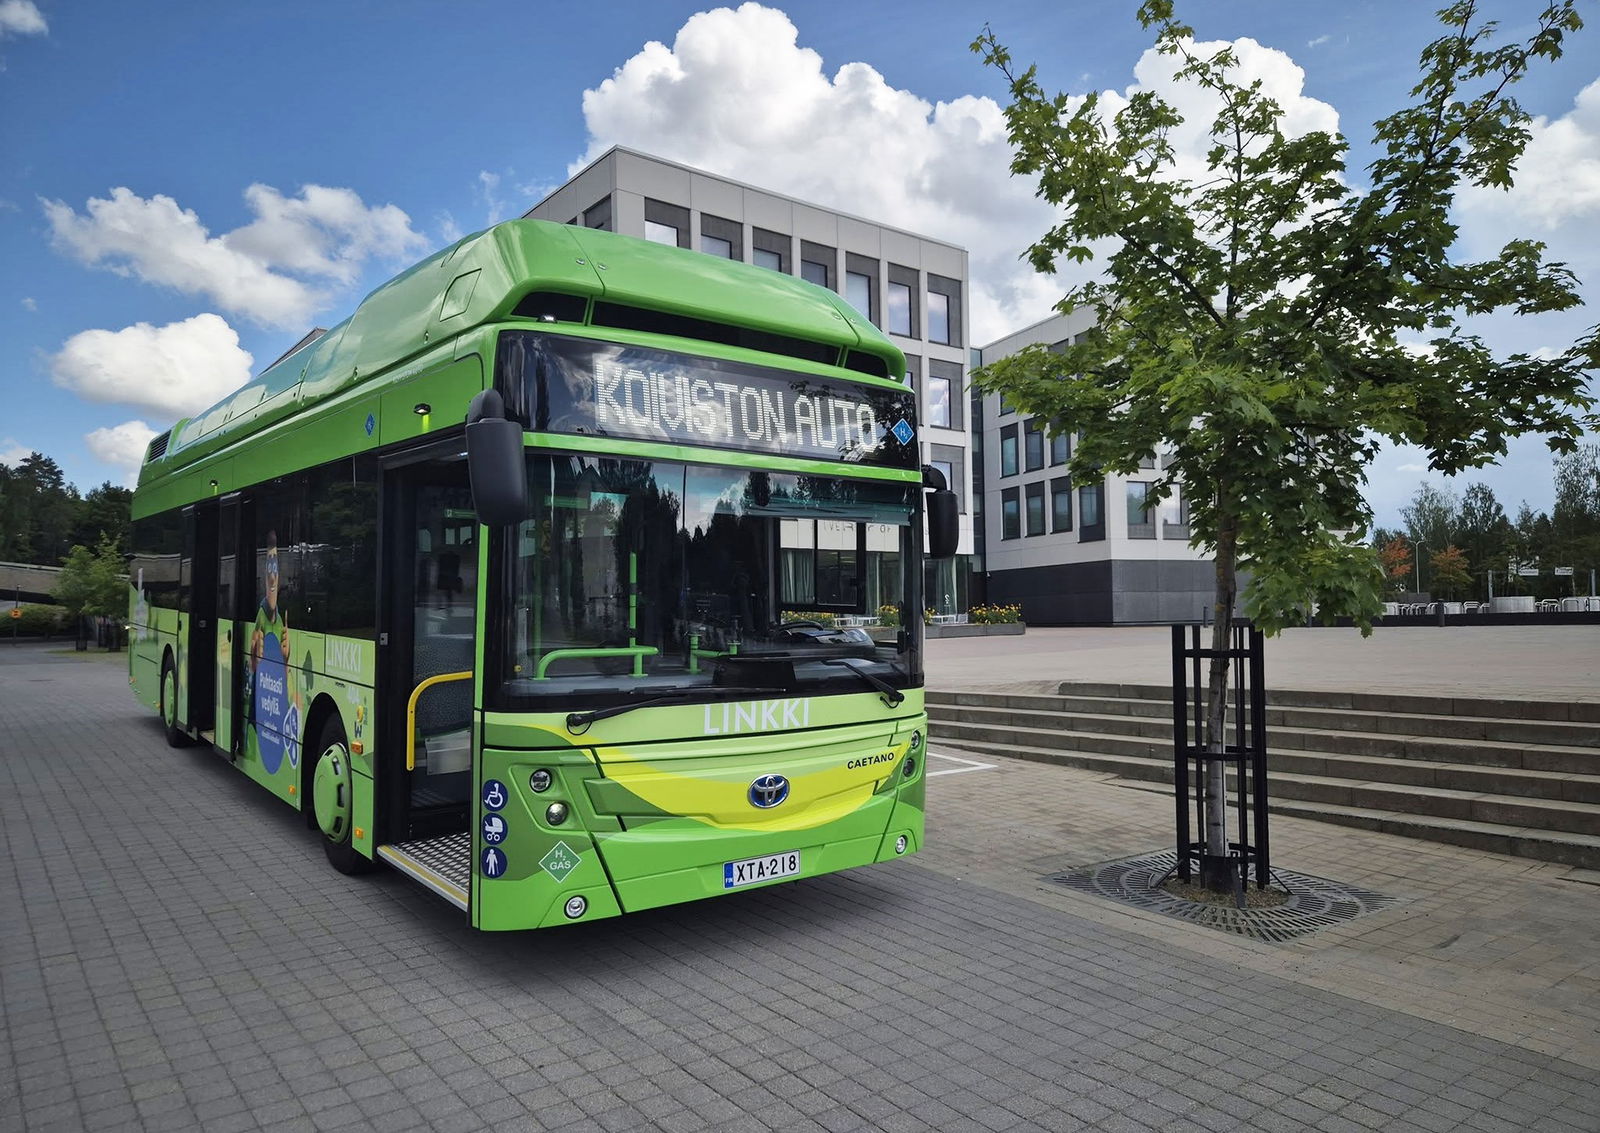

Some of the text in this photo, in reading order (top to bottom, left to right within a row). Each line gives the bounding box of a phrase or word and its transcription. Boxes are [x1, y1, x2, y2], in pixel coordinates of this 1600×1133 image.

[595, 364, 878, 453] KOIVISTON AUTO
[703, 698, 810, 735] LINKKI
[846, 752, 895, 770] CAETANO
[549, 860, 572, 870] GAS
[736, 854, 797, 883] XTA-218
